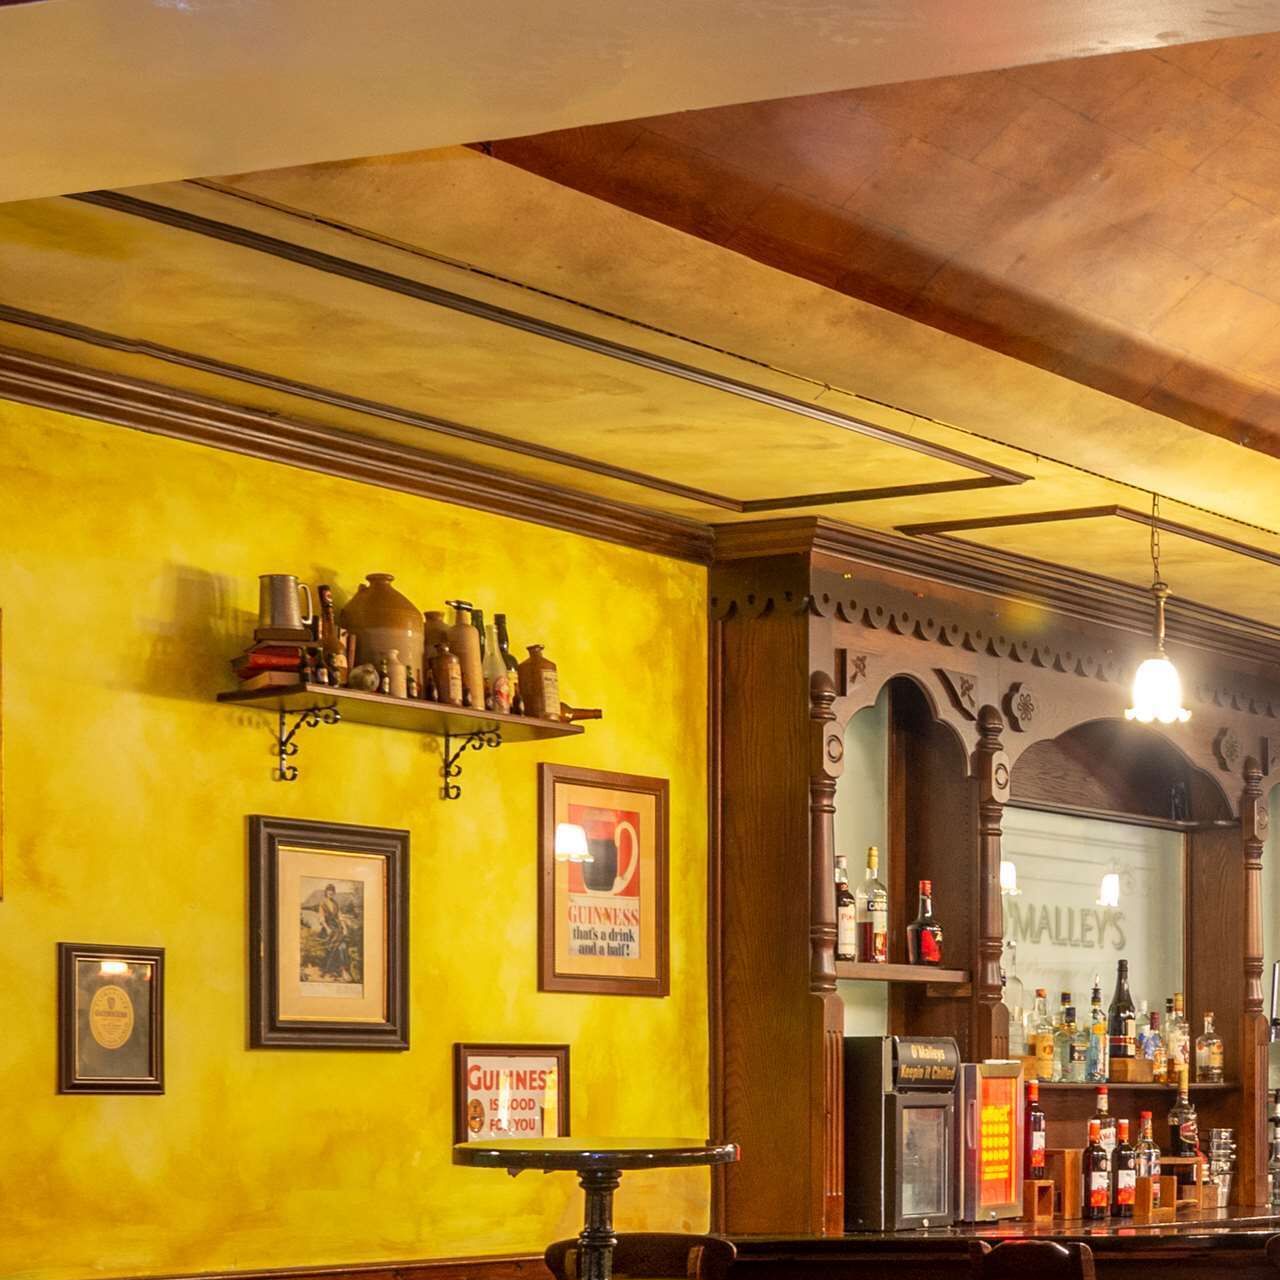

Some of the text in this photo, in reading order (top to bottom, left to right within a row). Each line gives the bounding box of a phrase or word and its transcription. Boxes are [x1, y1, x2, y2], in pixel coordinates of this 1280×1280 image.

[568, 906, 640, 926] GUINNESS
[573, 925, 599, 941] that's
[608, 928, 635, 943] drink
[578, 941, 597, 956] and
[607, 943, 630, 957] half!
[468, 1065, 556, 1091] GUINES
[901, 1065, 924, 1082] Keepin
[489, 1098, 536, 1111] IS OOD
[514, 1118, 536, 1131] YOU
